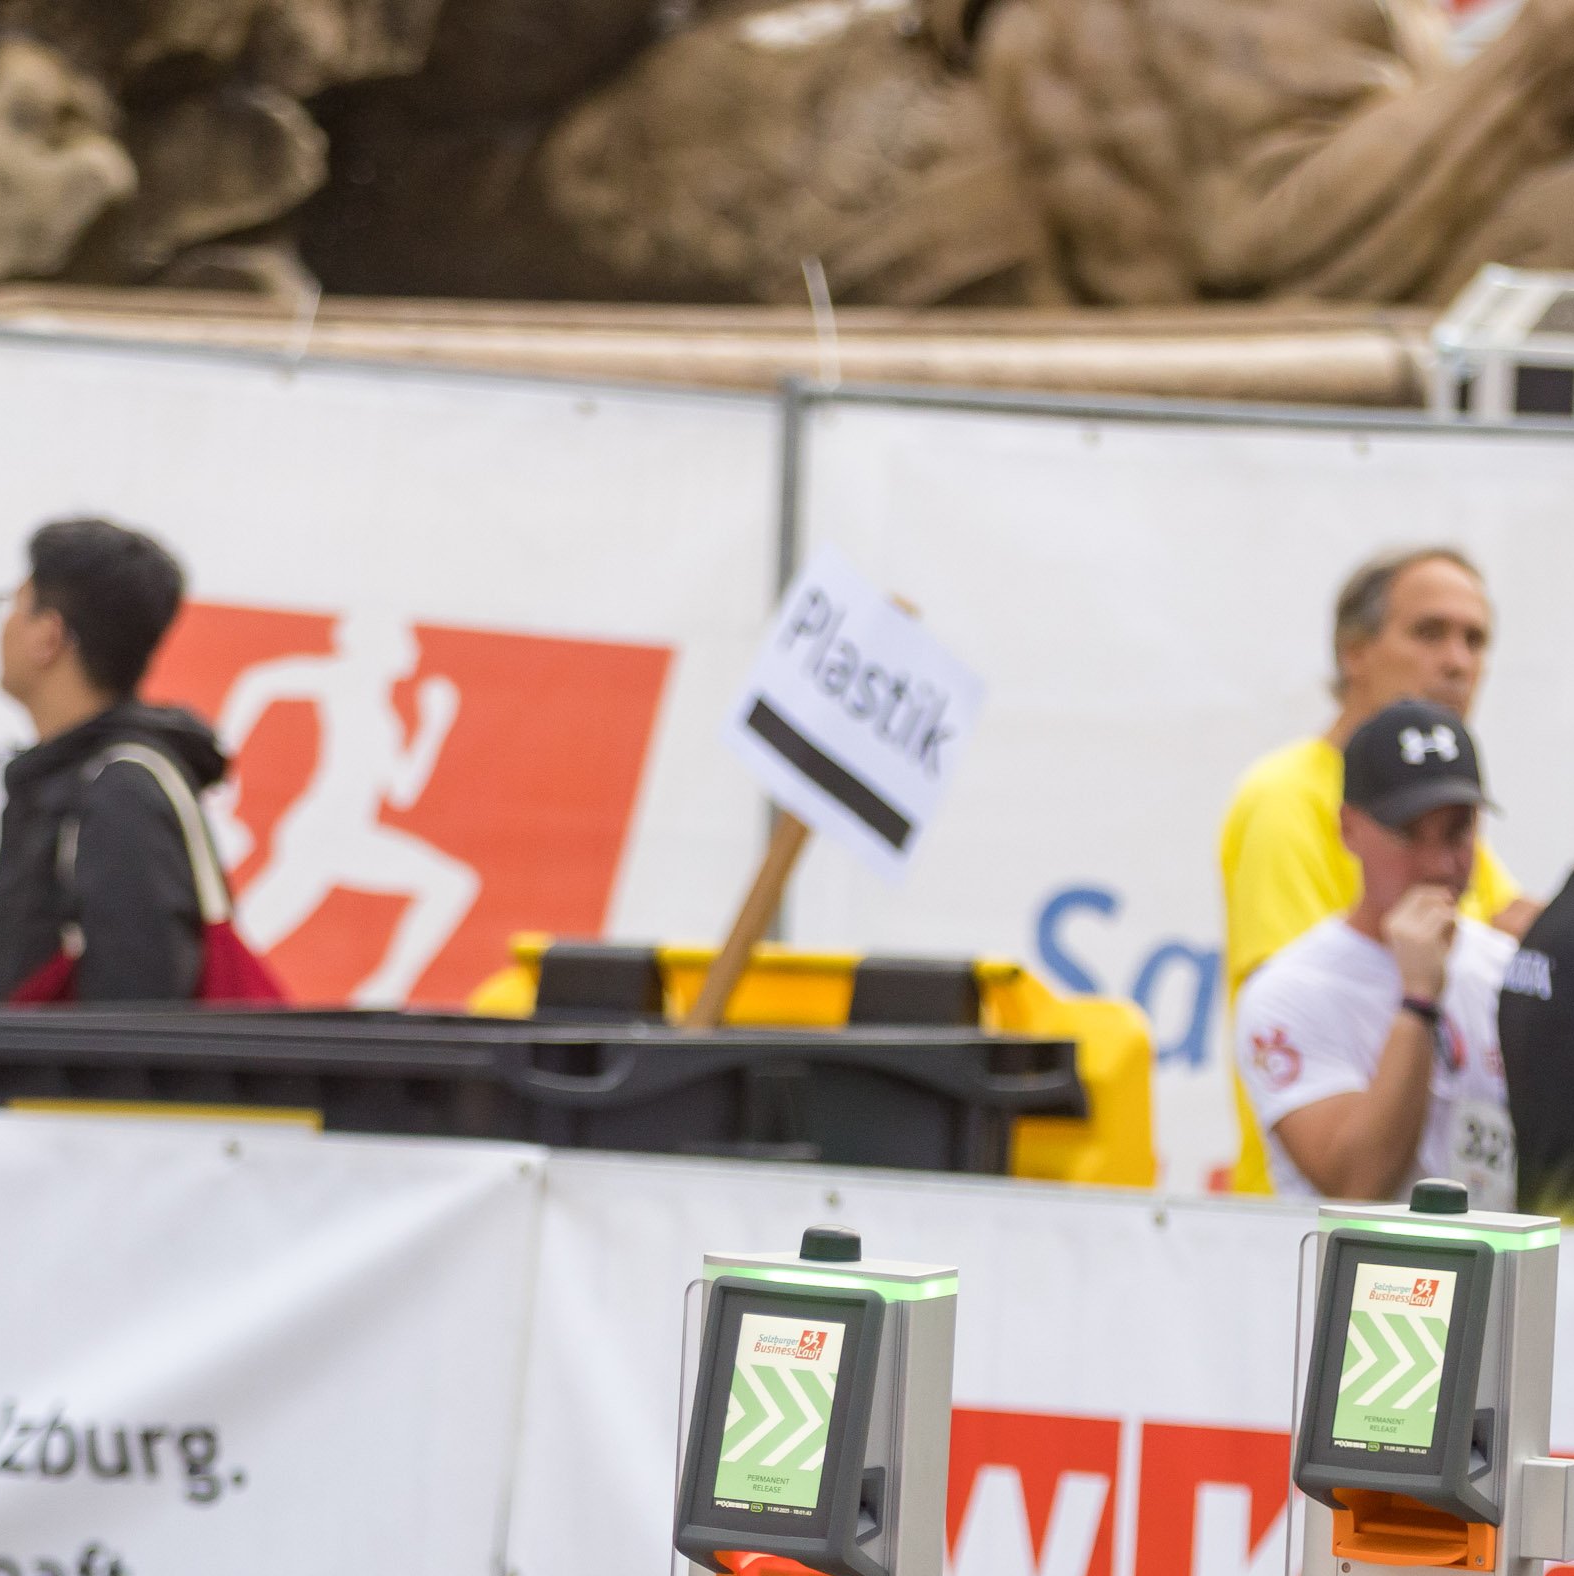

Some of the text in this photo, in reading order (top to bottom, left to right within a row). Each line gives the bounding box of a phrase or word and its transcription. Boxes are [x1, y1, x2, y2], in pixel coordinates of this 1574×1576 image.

[782, 588, 960, 780] Plastik
[1373, 1281, 1411, 1294] Salzburger
[758, 1333, 799, 1347] Salzburger
[1364, 1415, 1405, 1425] PERMANENT
[1369, 1424, 1397, 1433] RELEASE
[746, 1474, 789, 1485] PERMANENT
[752, 1484, 782, 1494] RELEASE
